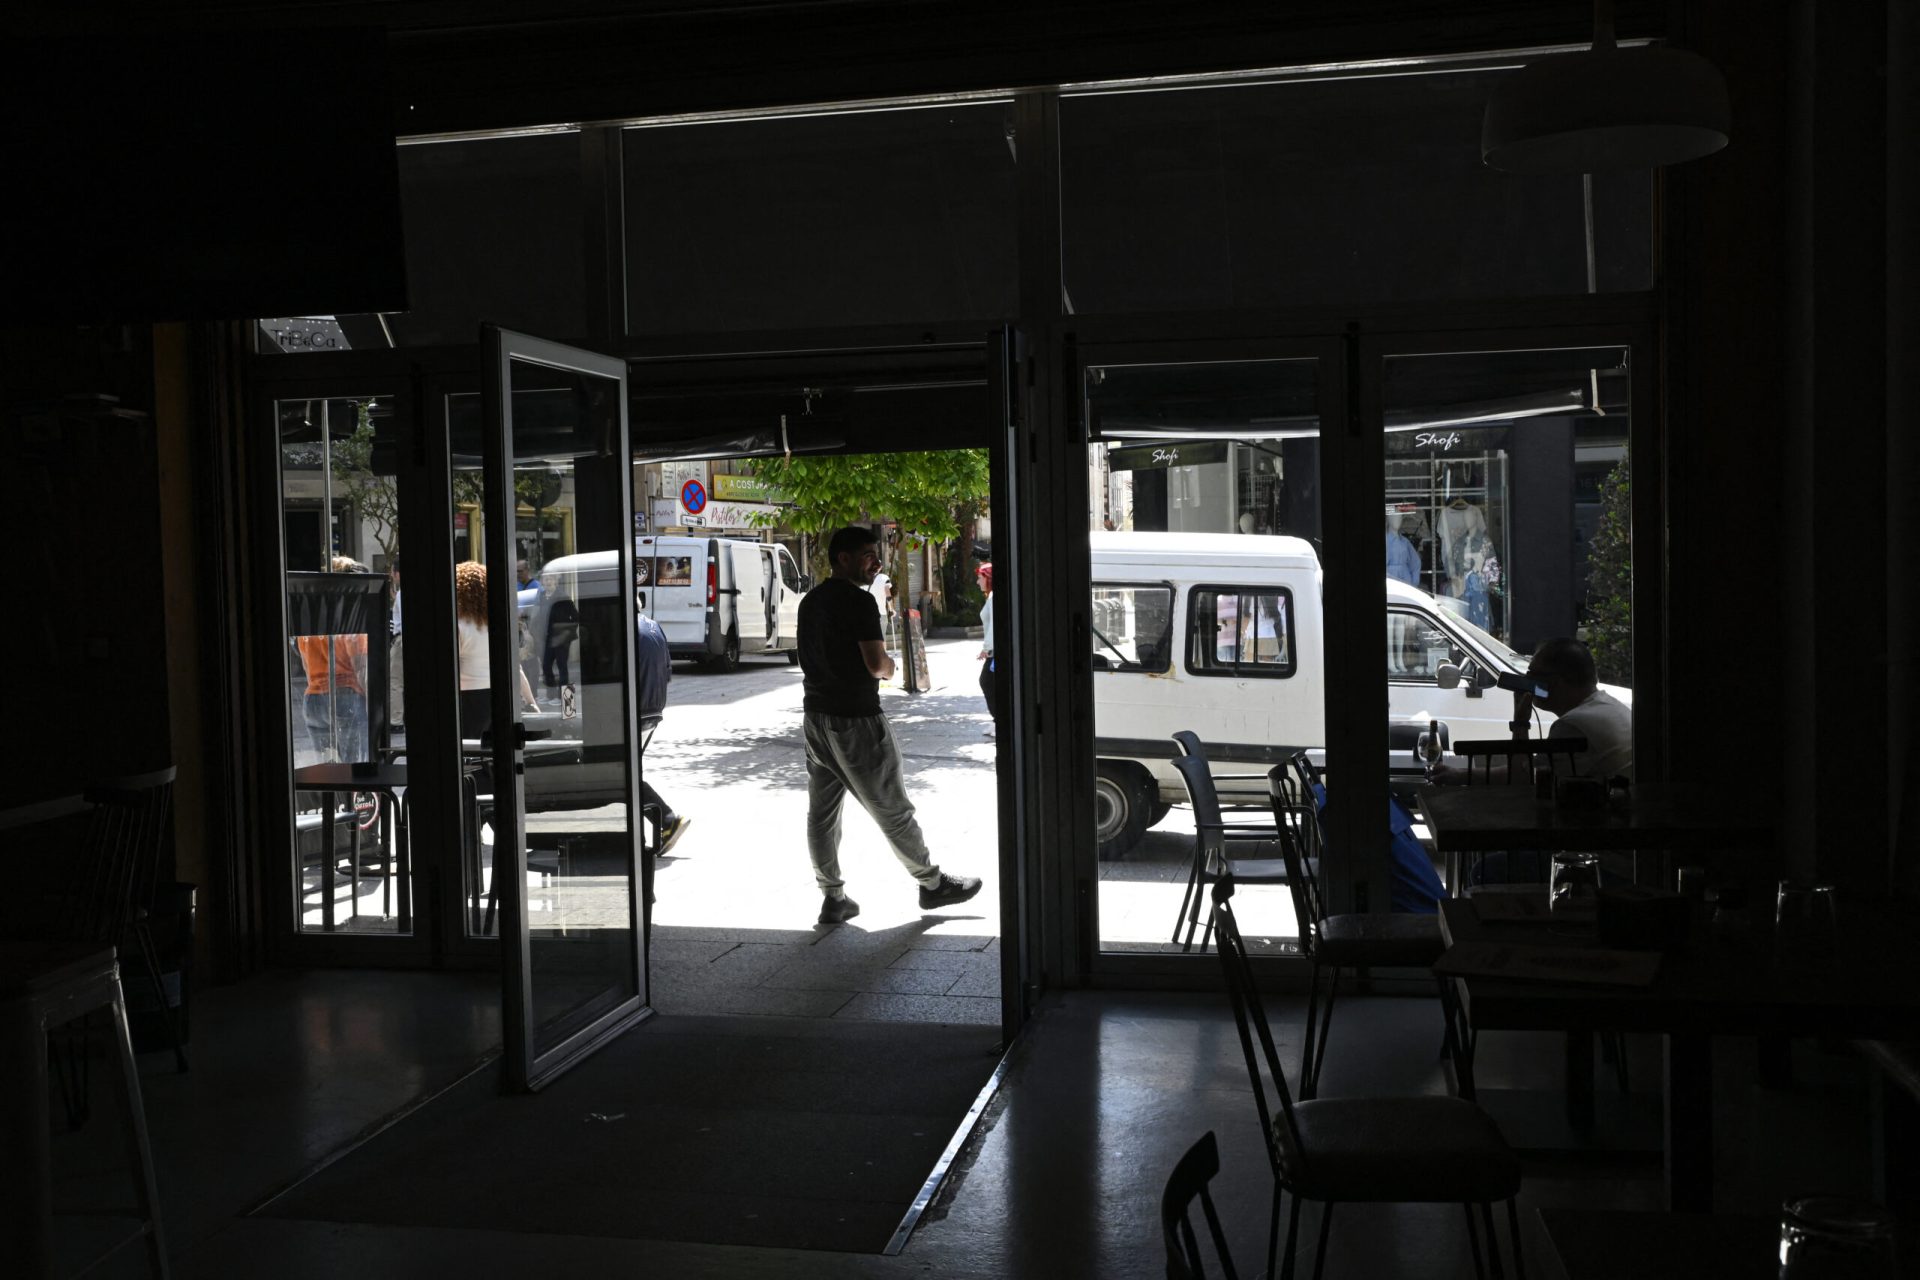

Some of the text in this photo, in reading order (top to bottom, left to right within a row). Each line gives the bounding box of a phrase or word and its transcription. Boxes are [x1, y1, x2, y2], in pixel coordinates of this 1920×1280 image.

[270, 329, 336, 348] TriBeCa
[1415, 432, 1461, 451] Shofi
[1152, 448, 1179, 466] Shofi
